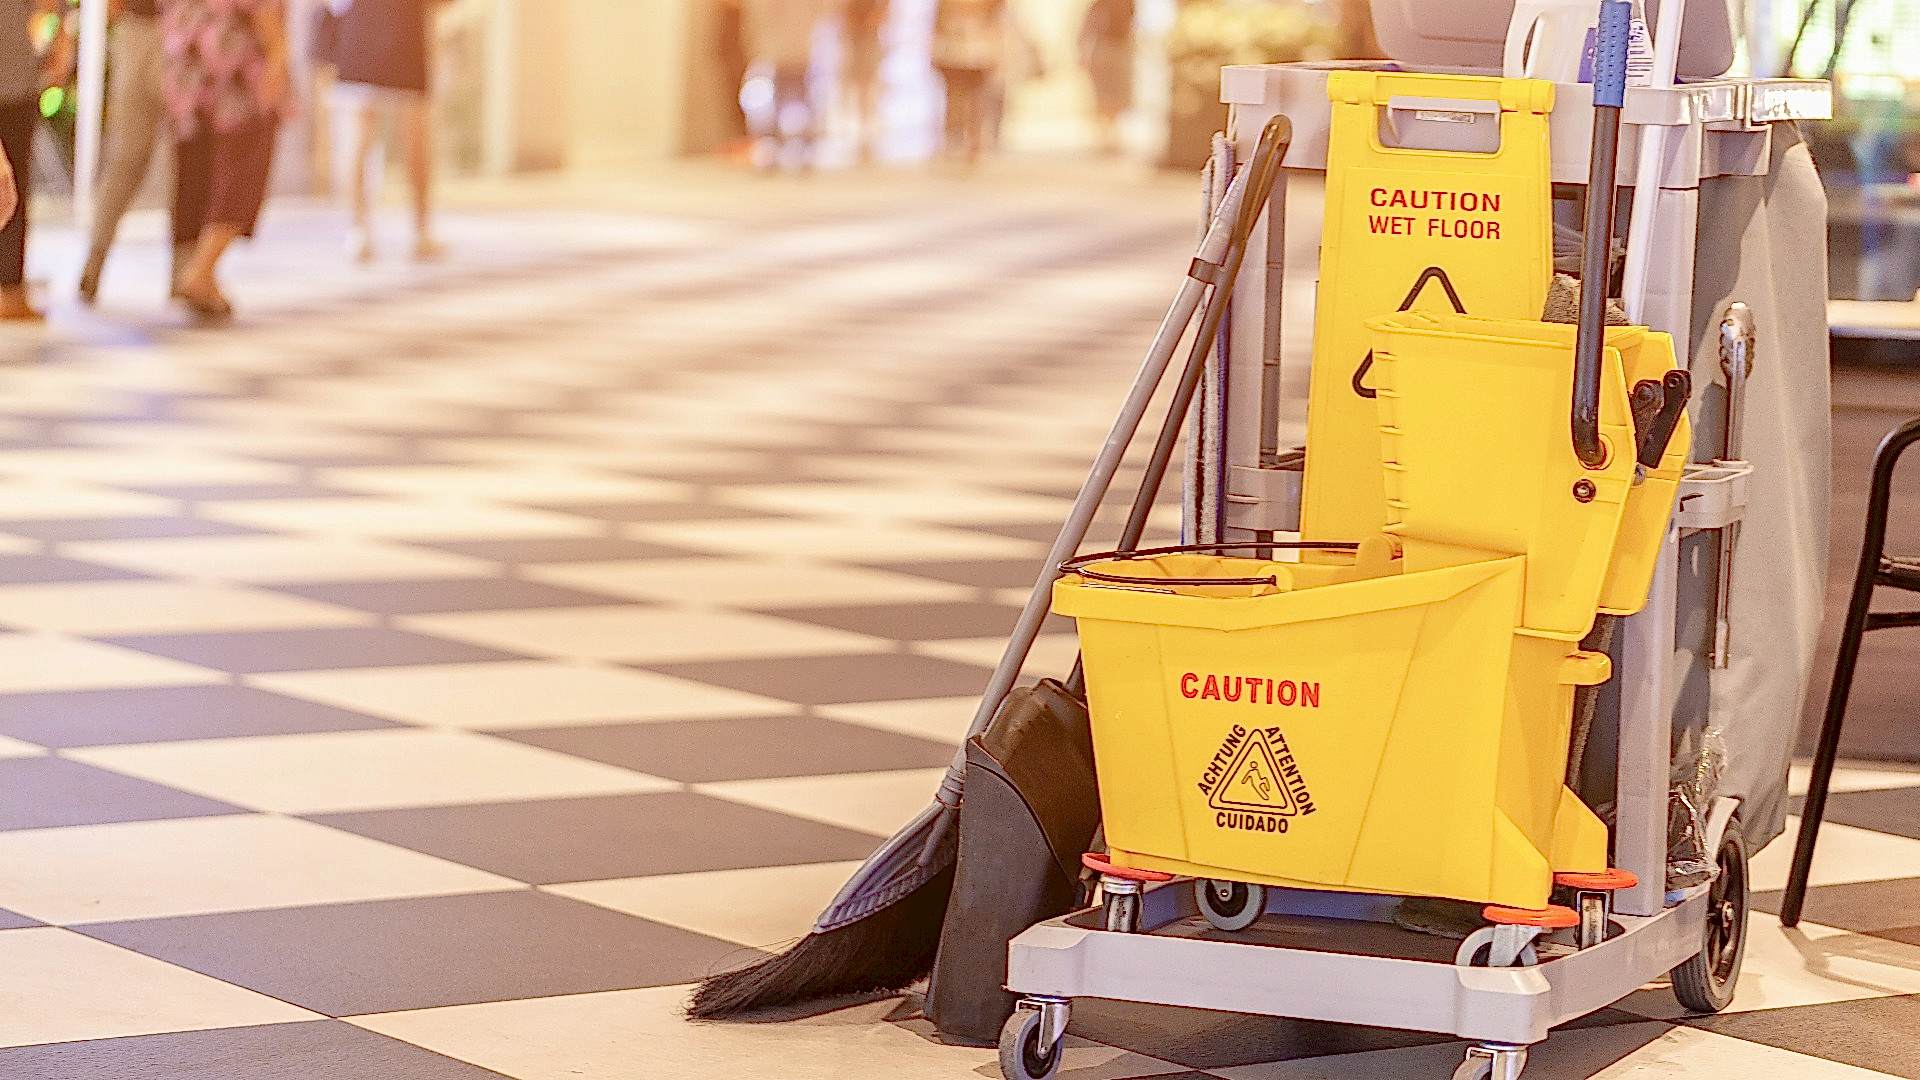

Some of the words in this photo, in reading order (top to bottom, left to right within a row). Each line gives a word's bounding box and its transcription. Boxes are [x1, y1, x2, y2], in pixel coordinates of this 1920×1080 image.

[1370, 187, 1500, 212] CAUTION
[1368, 215, 1416, 235] WET
[1428, 218, 1500, 240] FLOOR
[1180, 672, 1320, 708] CAUTION
[1197, 724, 1246, 796] ACHTUNG
[1264, 726, 1317, 816] ATTENTION
[1216, 811, 1289, 834] CUIDADO
